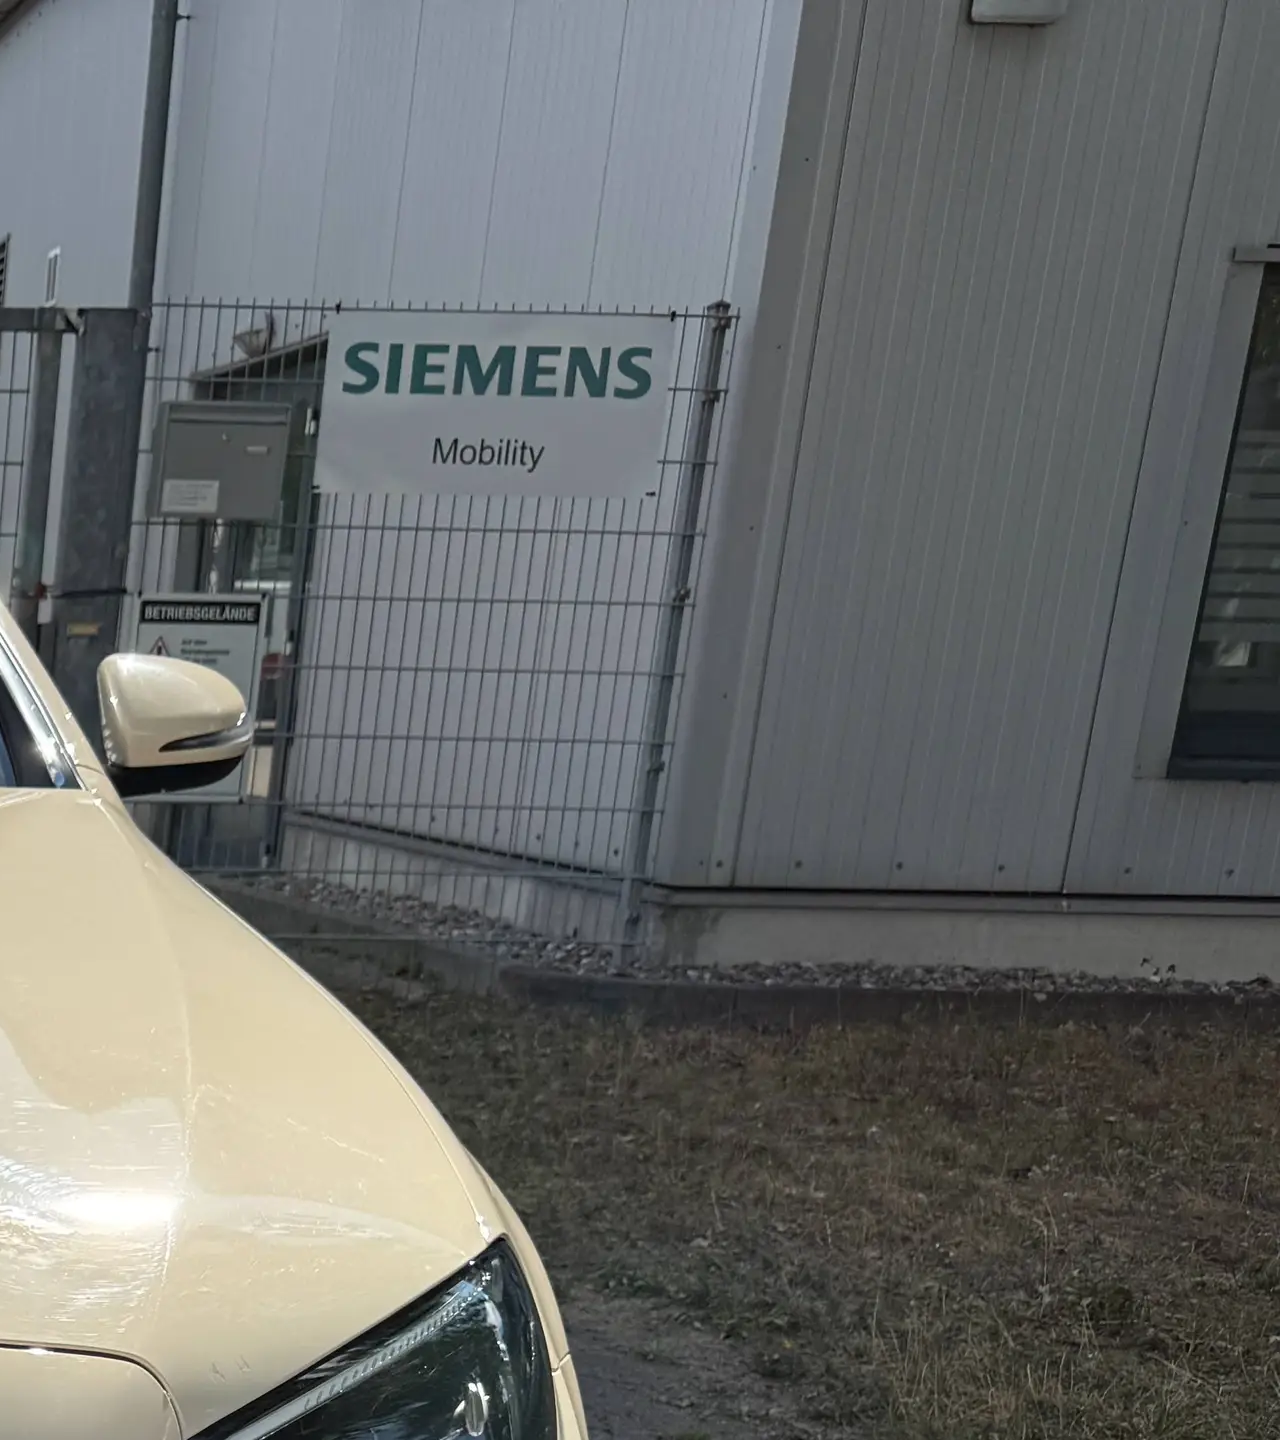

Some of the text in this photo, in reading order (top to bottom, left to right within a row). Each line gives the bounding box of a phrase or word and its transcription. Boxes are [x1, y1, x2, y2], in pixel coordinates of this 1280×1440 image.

[342, 342, 653, 399] SIEMENS
[432, 437, 545, 473] Mobility
[144, 604, 256, 620] BETRIEBSGELÄNDE
